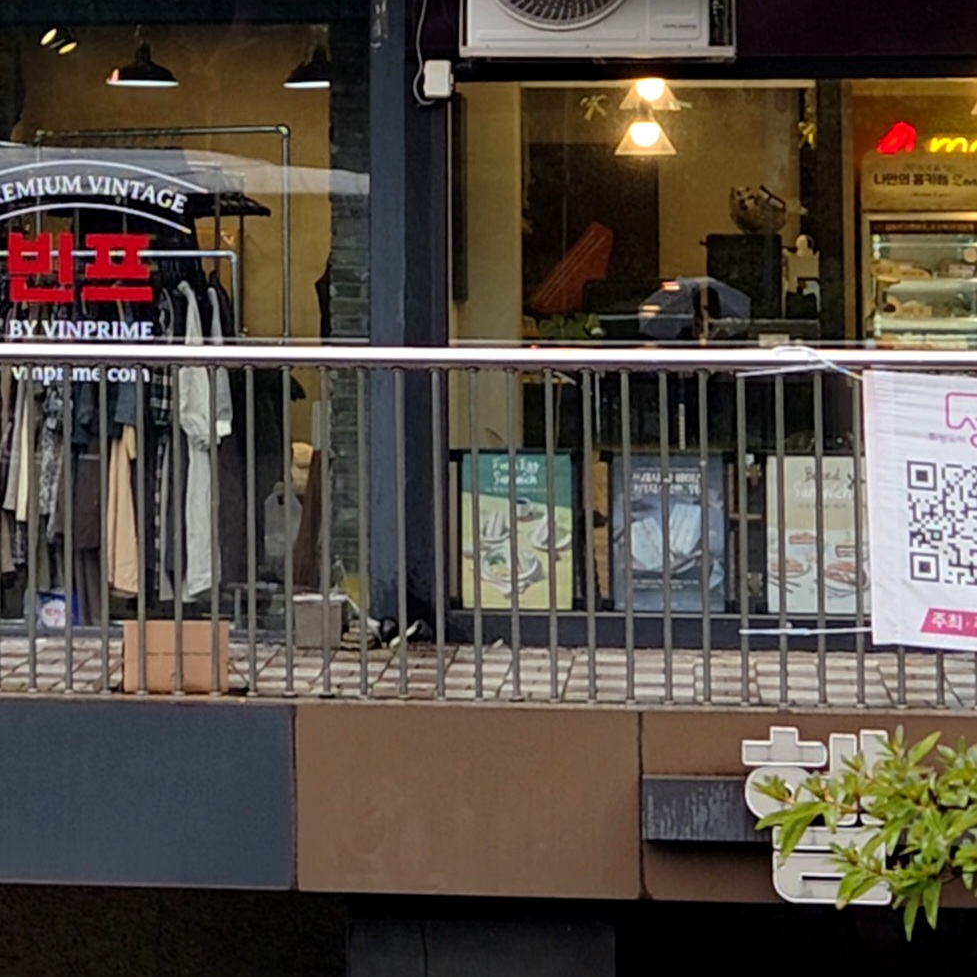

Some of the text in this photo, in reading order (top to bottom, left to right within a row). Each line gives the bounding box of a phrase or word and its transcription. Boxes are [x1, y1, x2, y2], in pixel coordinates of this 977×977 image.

[87, 174, 189, 215] VINTAGE
[6, 231, 154, 304] 빈프
[8, 319, 155, 341] BY VINPRIME
